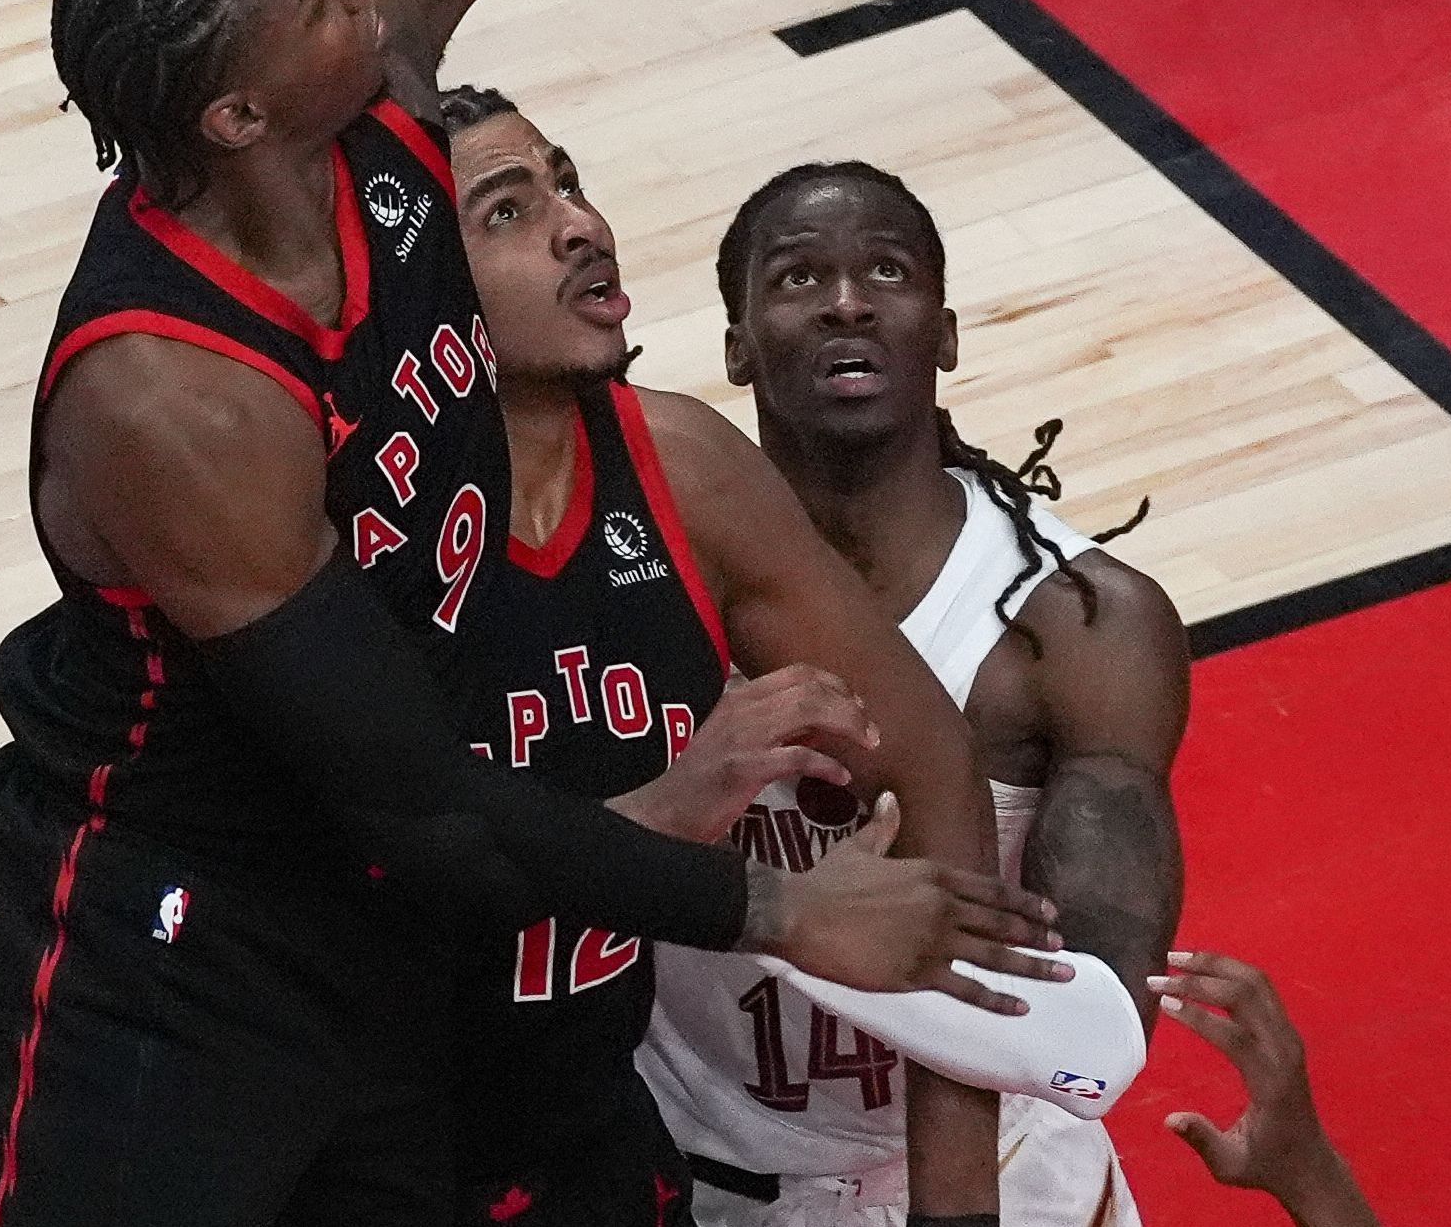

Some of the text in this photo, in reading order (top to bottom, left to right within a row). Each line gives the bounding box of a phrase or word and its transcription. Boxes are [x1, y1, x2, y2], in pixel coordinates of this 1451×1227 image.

[395, 194, 432, 263] Sun Life
[432, 483, 486, 633] 9
[609, 559, 669, 588] Sun Life
[739, 976, 898, 1111] 14
